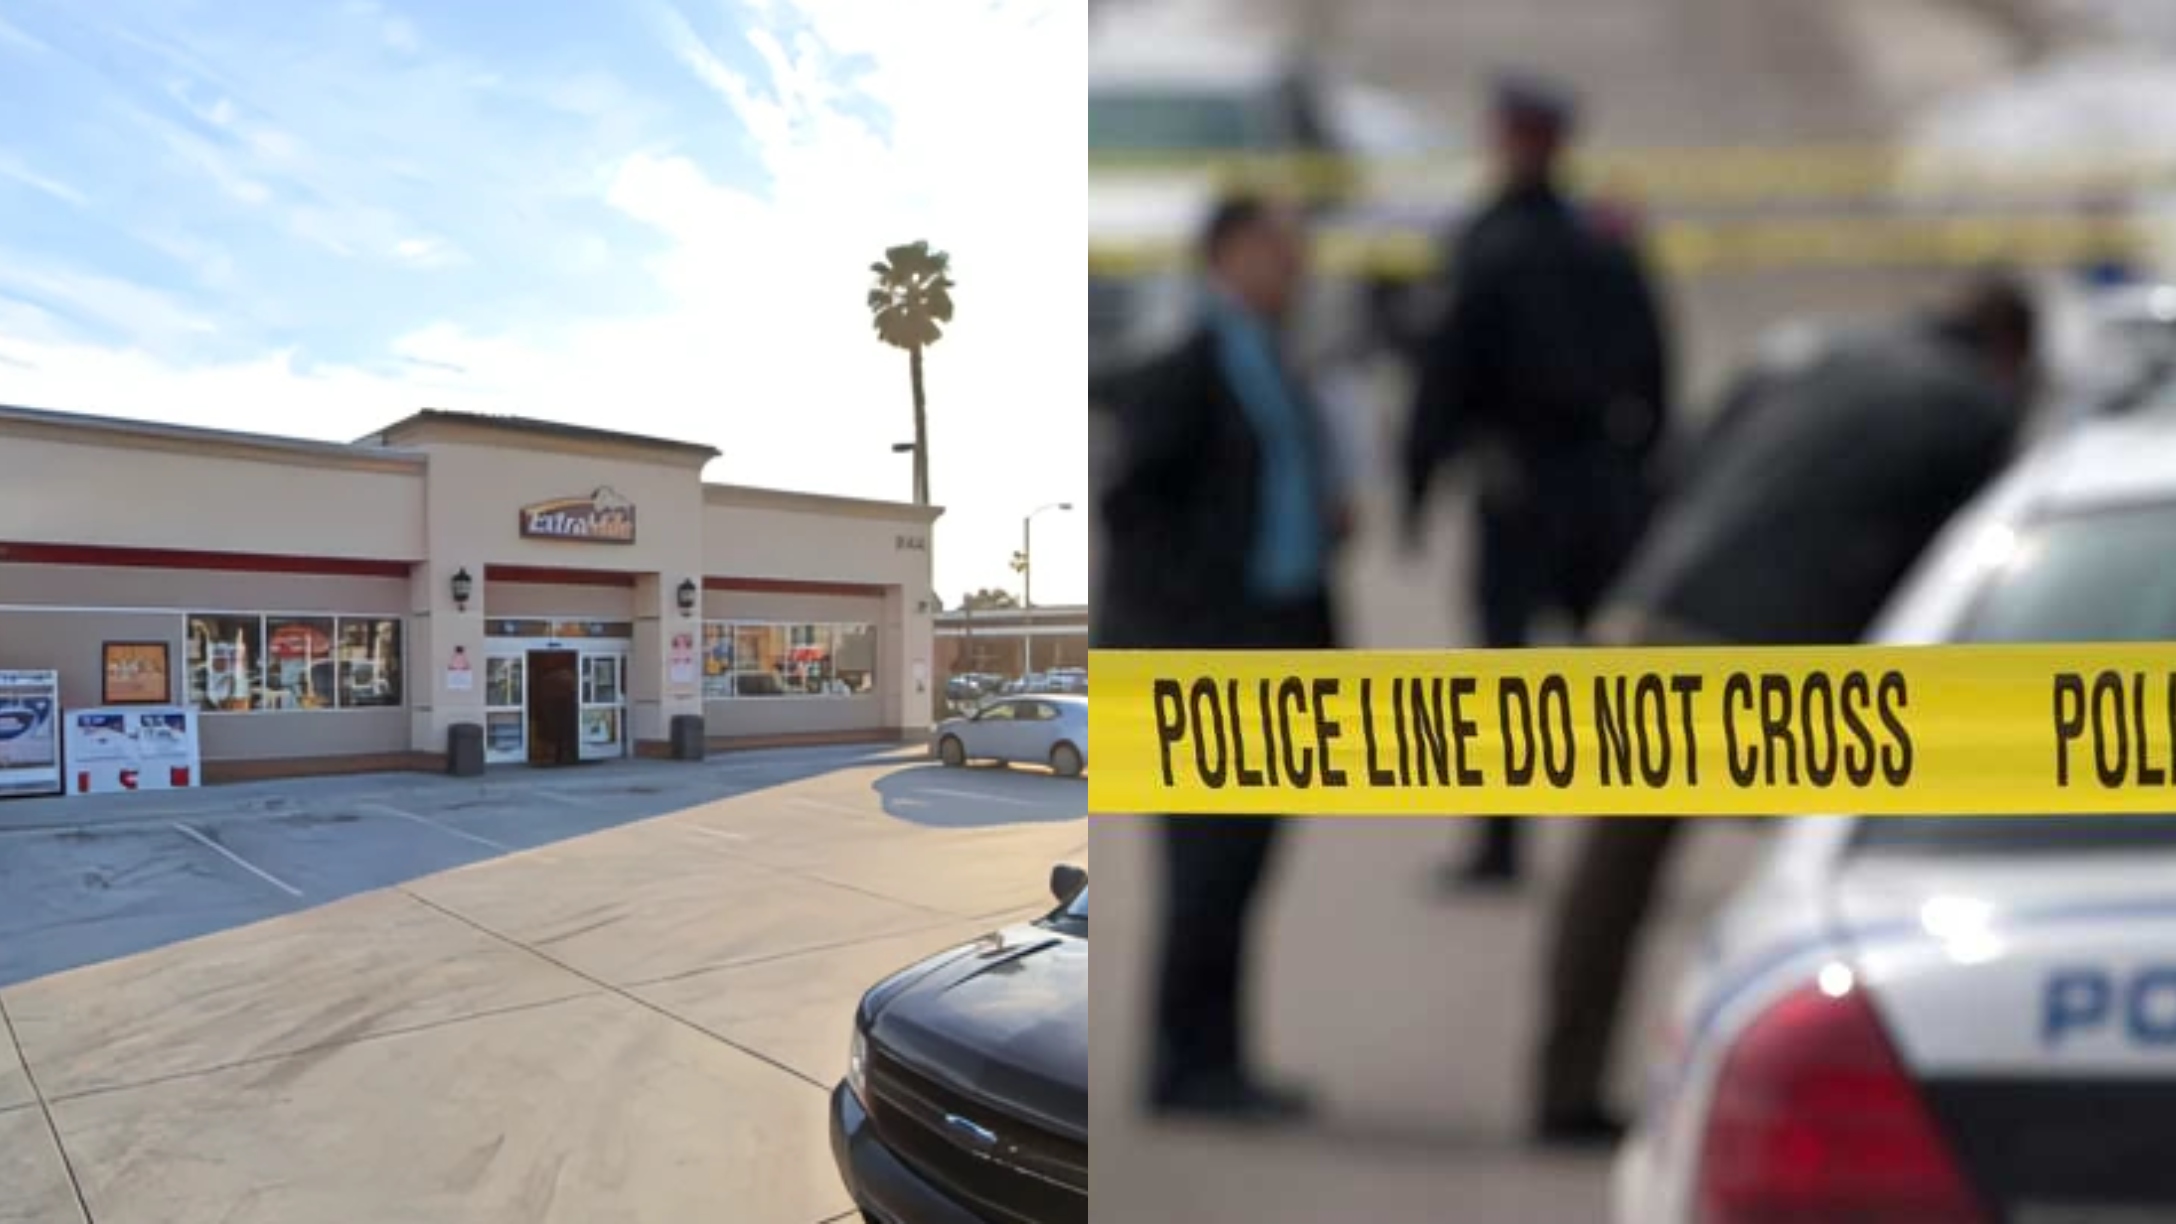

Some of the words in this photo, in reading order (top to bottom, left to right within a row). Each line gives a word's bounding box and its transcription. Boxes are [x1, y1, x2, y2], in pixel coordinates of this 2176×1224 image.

[1152, 674, 1347, 789] POLICE
[1359, 676, 1483, 787] LINE
[1497, 673, 1576, 789] DO
[1592, 672, 1703, 788] NOT
[1722, 669, 1913, 788] CROSS
